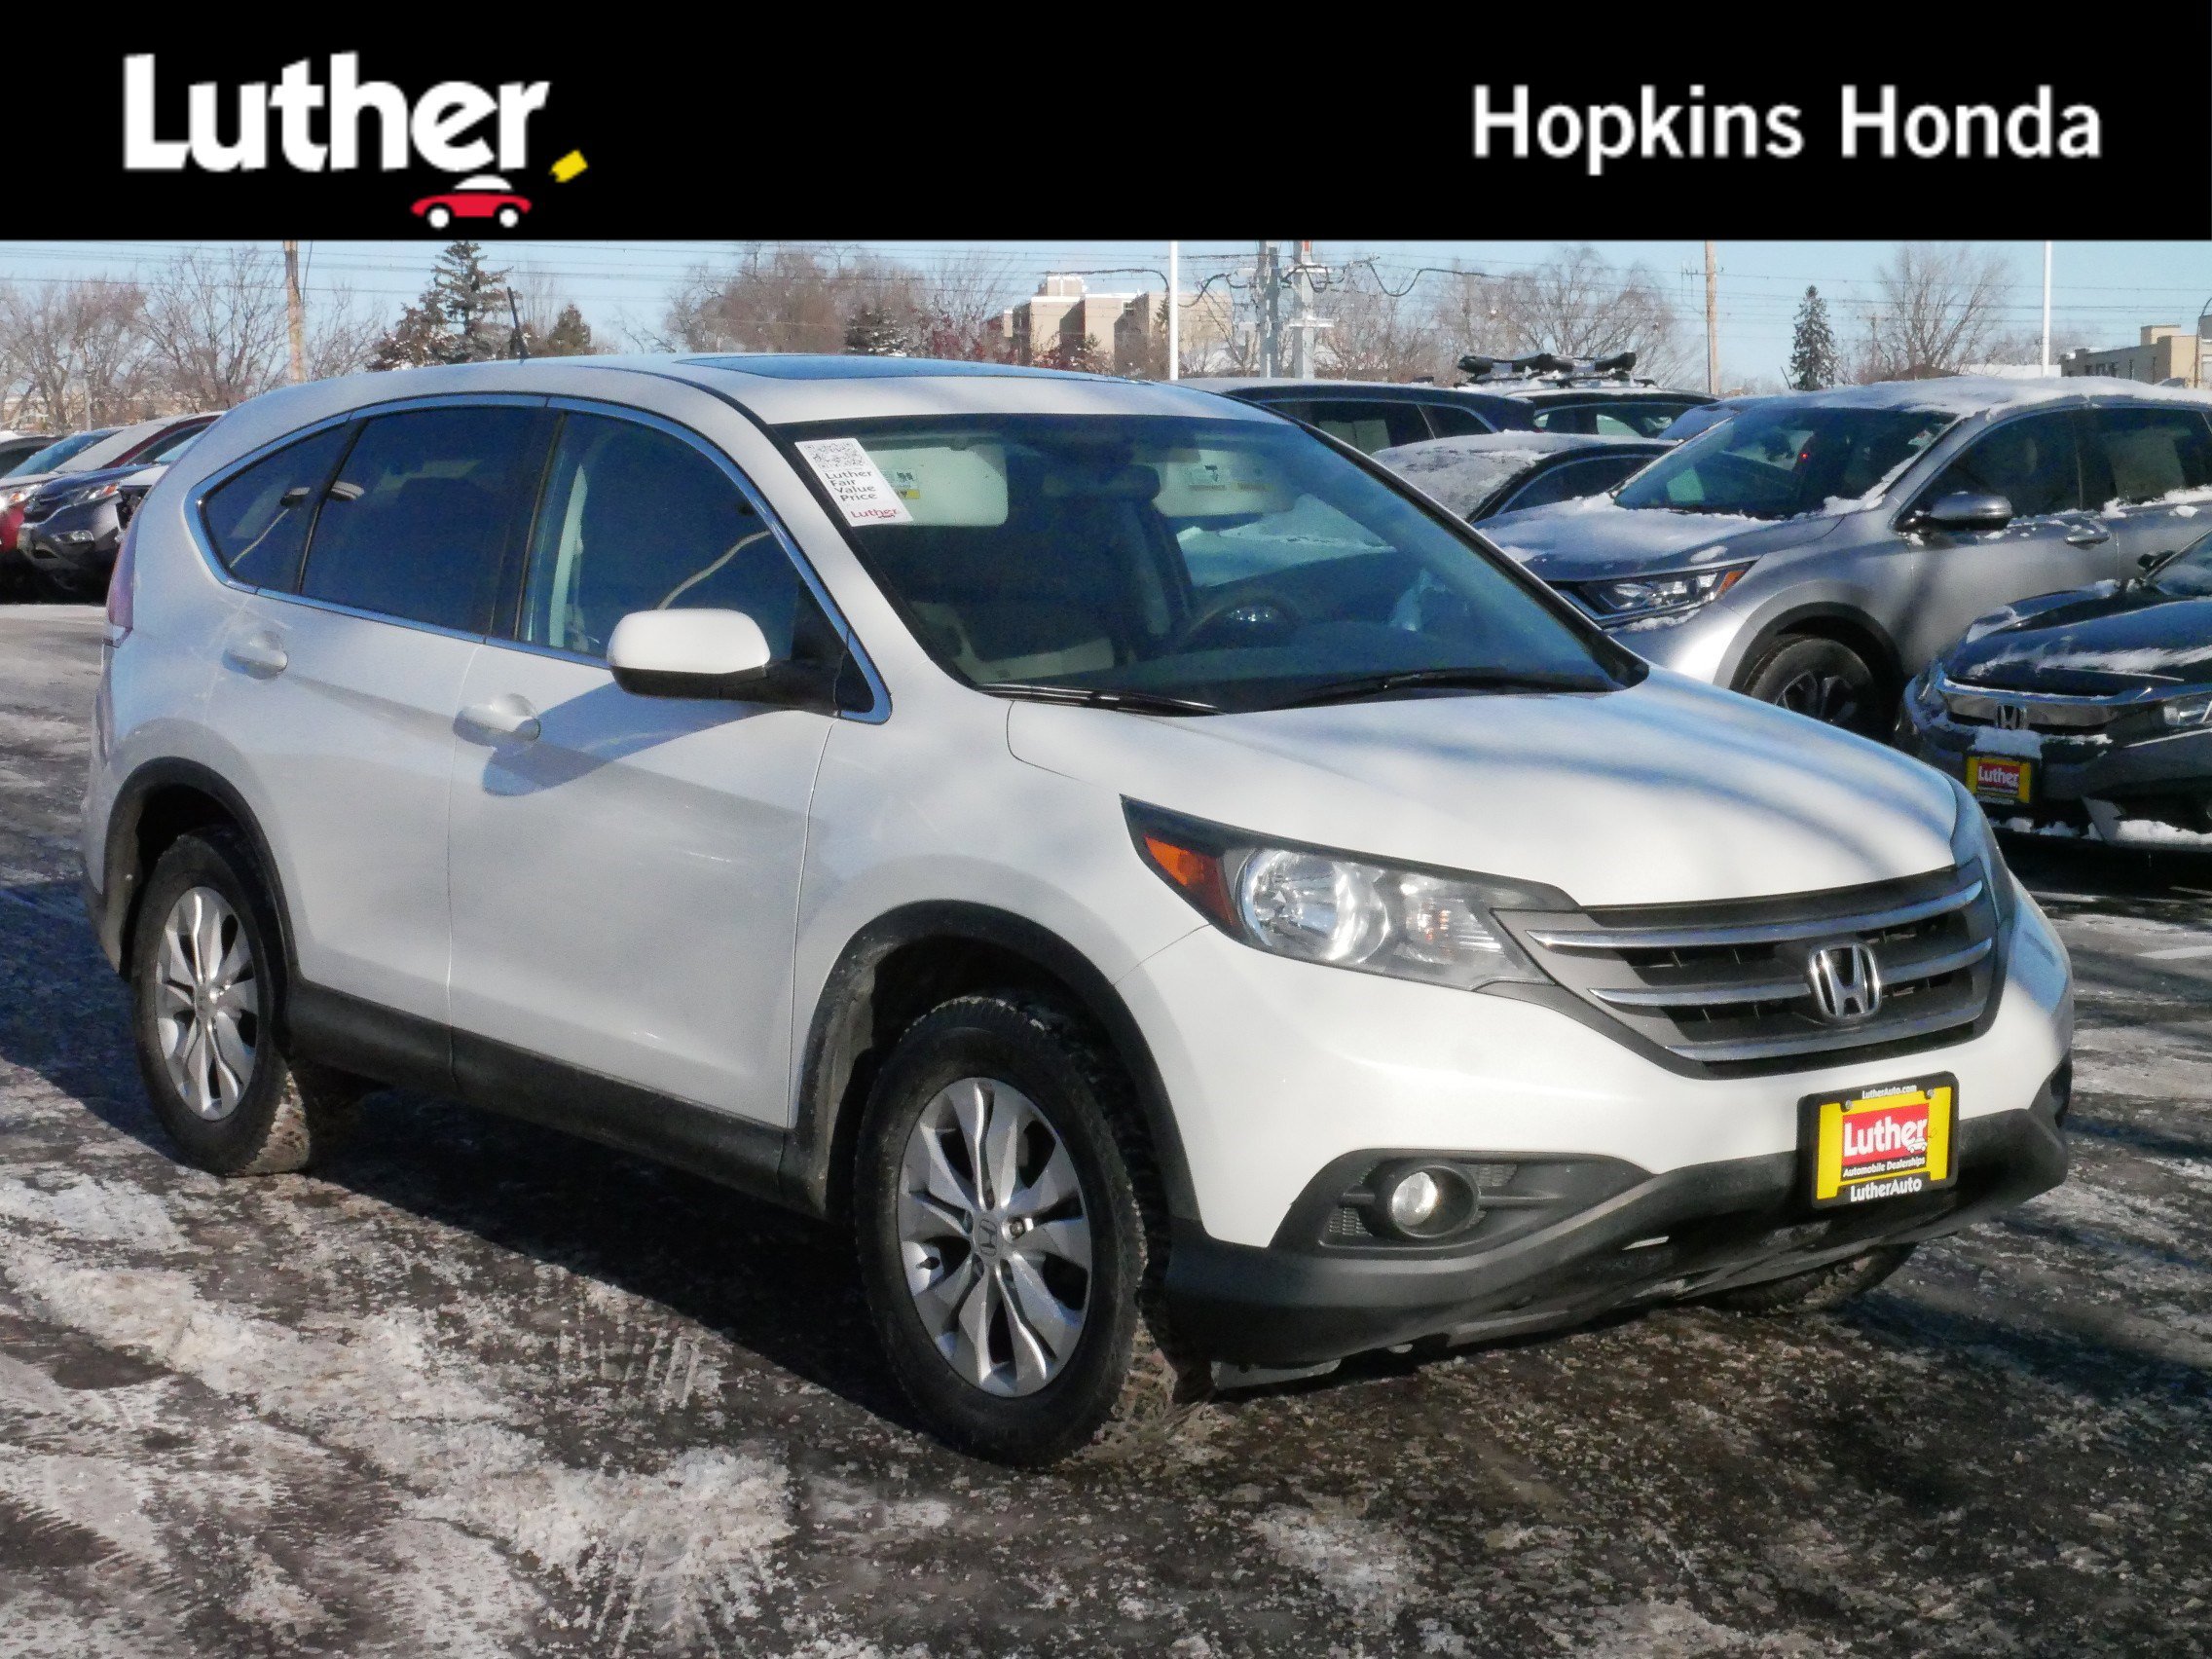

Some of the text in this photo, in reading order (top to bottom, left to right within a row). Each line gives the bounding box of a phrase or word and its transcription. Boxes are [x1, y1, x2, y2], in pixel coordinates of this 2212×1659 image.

[825, 470, 872, 480] Luther
[830, 478, 856, 487] Fair
[834, 485, 877, 494] Value
[840, 493, 877, 501] Price
[850, 508, 899, 519] Luther
[1862, 1085, 1917, 1099] LutherAuto.com
[1844, 1116, 1928, 1158] Luther
[1843, 1156, 1926, 1177] Automobile Dealerships
[1850, 1177, 1923, 1202] LutherAuto
